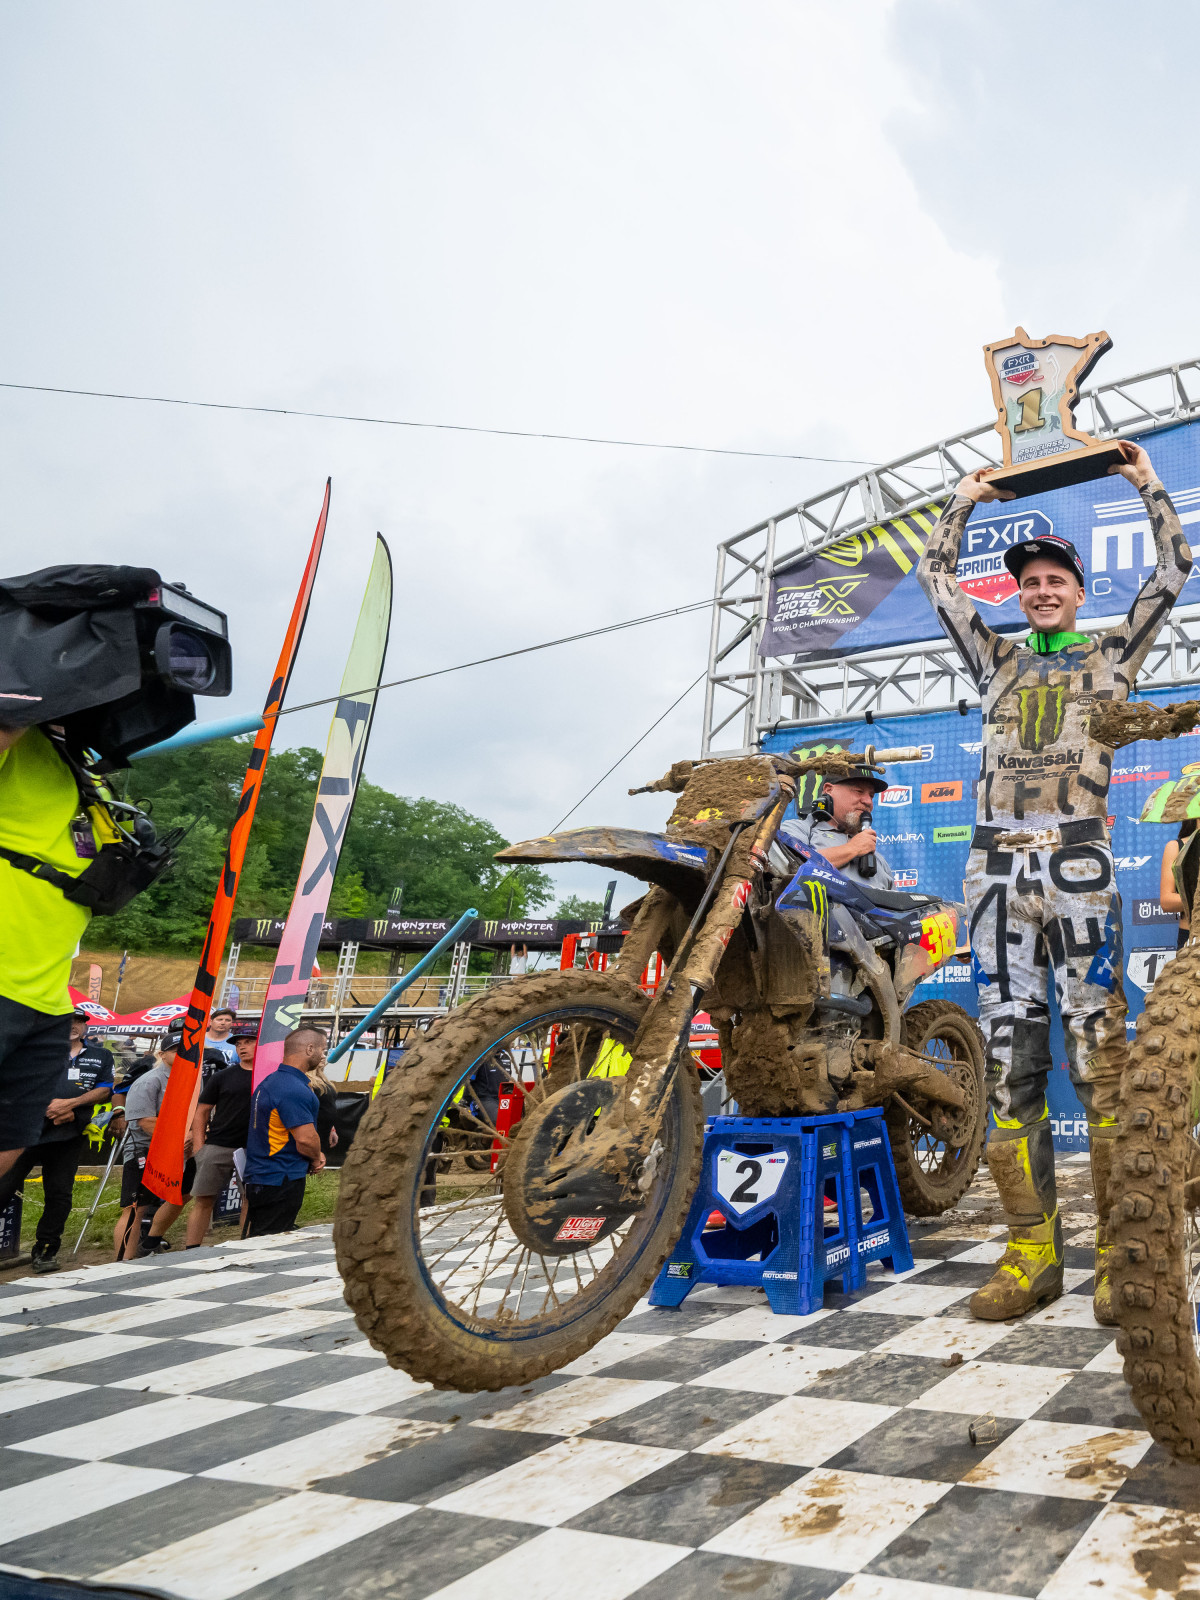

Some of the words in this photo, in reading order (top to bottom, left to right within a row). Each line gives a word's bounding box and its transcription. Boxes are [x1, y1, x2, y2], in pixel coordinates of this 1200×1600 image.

[1007, 354, 1030, 368] FXR
[1014, 387, 1045, 433] 1
[967, 519, 1035, 552] FXR
[956, 556, 1001, 578] SPRING
[967, 573, 1016, 589] NATION
[775, 588, 823, 605] SUPER
[777, 599, 820, 614] MOTO
[773, 607, 819, 623] CROSS
[772, 621, 799, 633] WORLD
[799, 615, 861, 630] CHAMPIONSHIP
[997, 749, 1084, 769] Kawasaki
[1002, 773, 1026, 782] PRO
[1025, 766, 1080, 781] CIRCUIT
[1111, 764, 1152, 776] MX-ATV
[881, 787, 909, 803] 100%
[928, 786, 955, 798] KTM
[876, 833, 925, 843] NAMURA
[937, 830, 968, 840] Kawasaki
[391, 921, 446, 931] MONSTER
[501, 922, 553, 931] MONSTER
[920, 912, 957, 966] 38
[944, 965, 971, 977] PRO
[87, 1025, 169, 1034] PROMOTOCR
[729, 1159, 763, 1203] 2
[762, 1272, 798, 1280] MOTOCROSS
